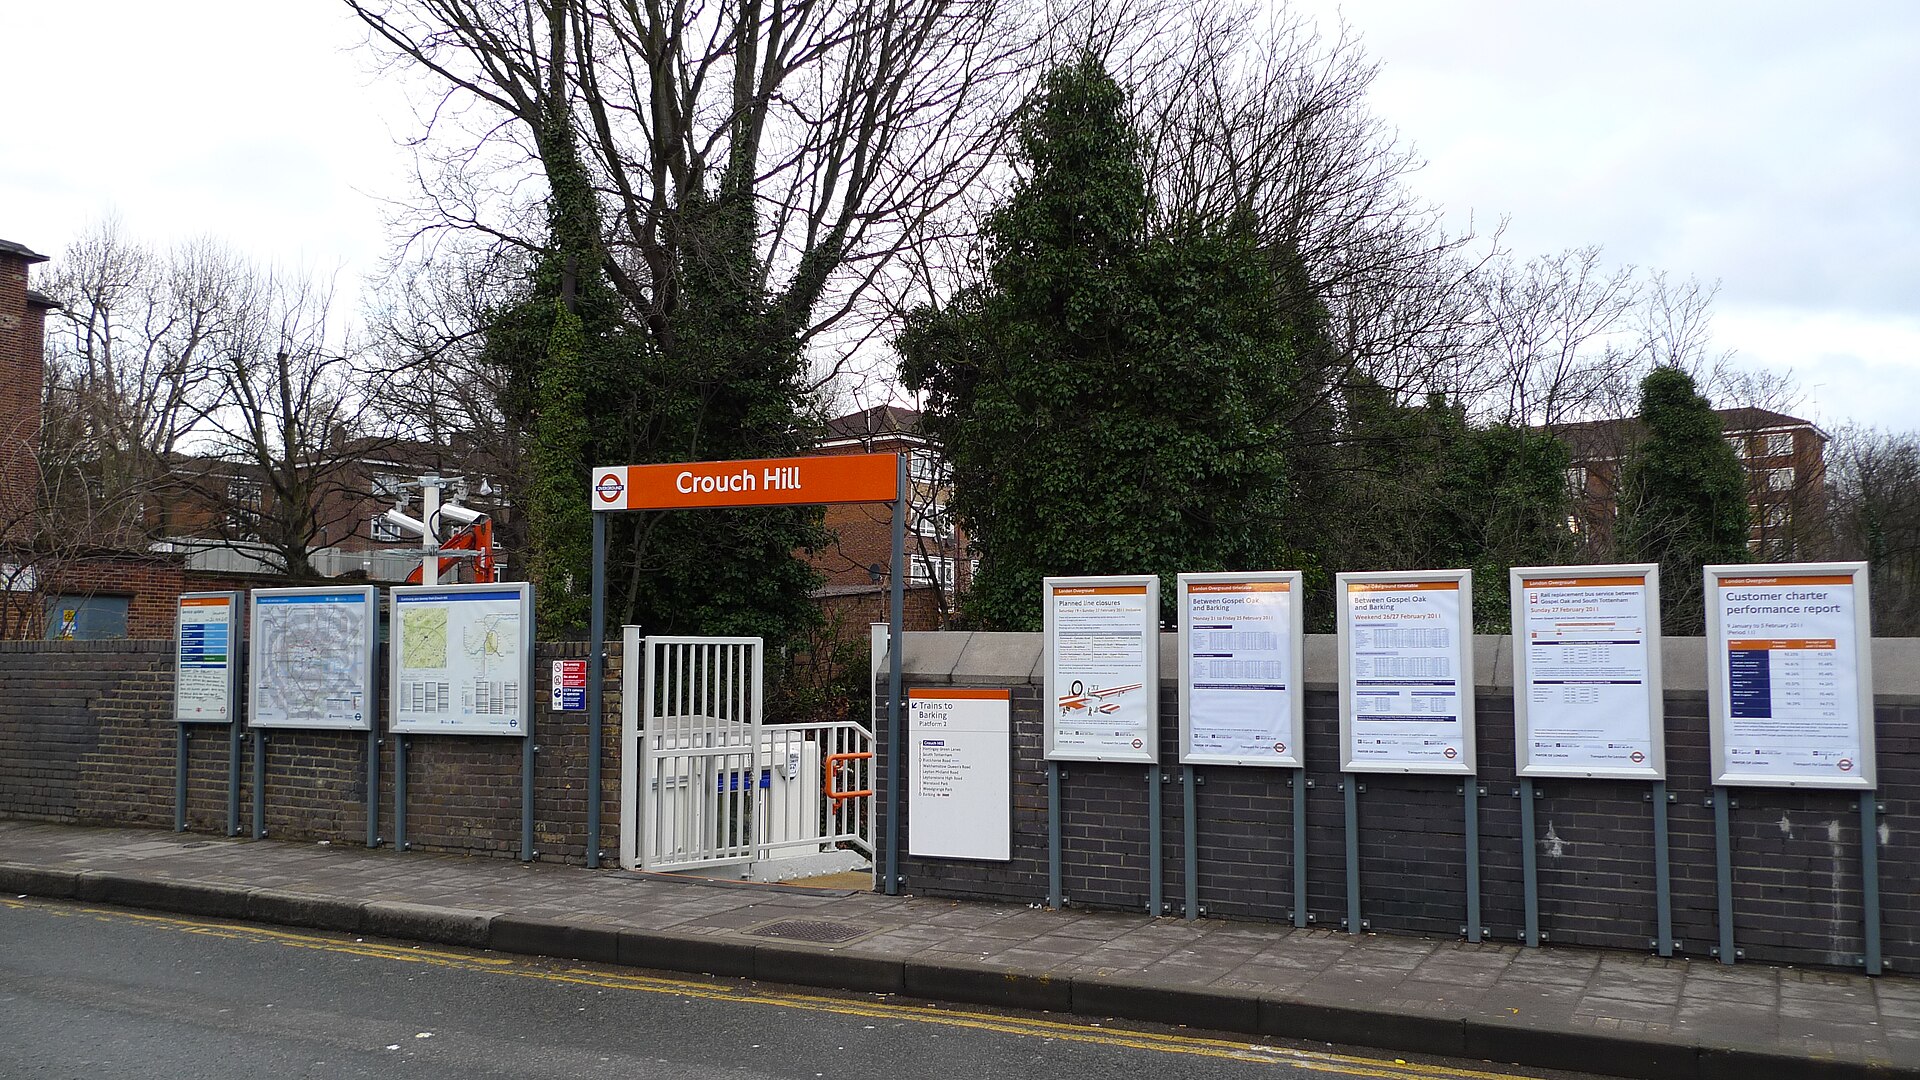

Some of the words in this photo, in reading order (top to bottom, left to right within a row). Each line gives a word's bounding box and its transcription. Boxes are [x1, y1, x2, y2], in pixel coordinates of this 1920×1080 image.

[676, 469, 756, 493] Crouch
[763, 467, 801, 490] Hill
[1726, 592, 1782, 601] Customer
[1786, 591, 1828, 600] charter
[1726, 604, 1800, 616] performance
[1804, 604, 1840, 614] report
[919, 711, 947, 720] Barking
